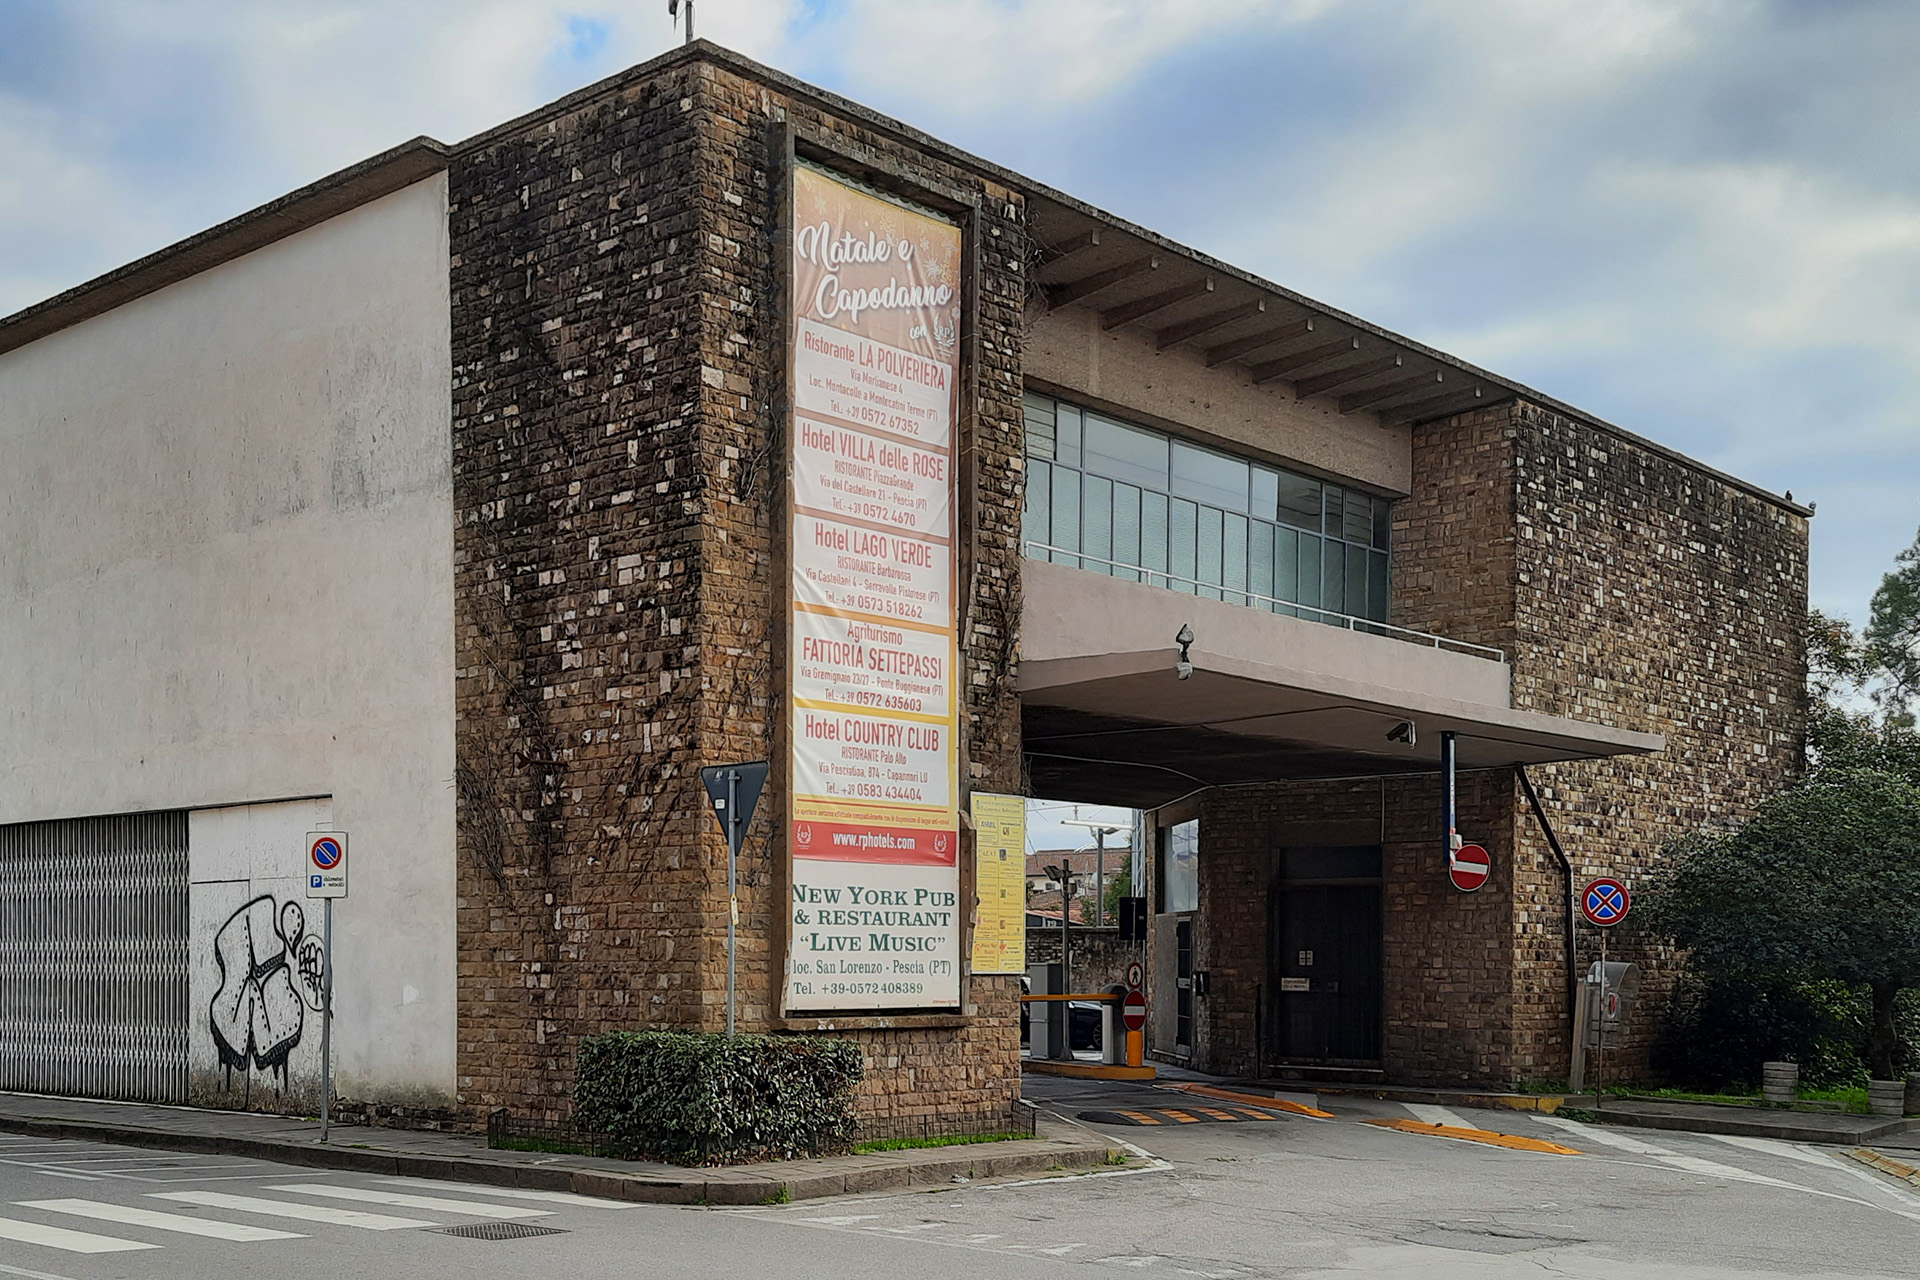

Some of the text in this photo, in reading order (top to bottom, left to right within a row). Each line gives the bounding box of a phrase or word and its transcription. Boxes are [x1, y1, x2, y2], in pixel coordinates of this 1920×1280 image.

[798, 221, 914, 271] Natale e
[816, 274, 952, 324] Capodanno
[804, 331, 945, 391] Ristorante LA POLVERIERA
[850, 368, 860, 381] Via
[899, 384, 903, 395] 4
[809, 374, 824, 389] Loc.
[864, 391, 868, 401] a
[870, 391, 905, 412] Montecatini
[907, 401, 925, 418] Terme
[927, 409, 938, 422] (PT)
[845, 405, 859, 418] +39
[862, 407, 886, 426] 0572
[889, 415, 919, 435] 67352
[802, 423, 944, 480] Hotel VILLA delle ROSE
[835, 460, 914, 491] RISTORANTE PiazzaGrande
[820, 475, 830, 488] Via
[833, 479, 842, 490] del
[844, 481, 876, 498] Castellare
[879, 489, 885, 500] 21
[894, 492, 914, 507] Pescia
[916, 499, 927, 511] (PT)
[847, 503, 861, 514] +39
[864, 504, 888, 521] 0572
[892, 510, 915, 526] 4670
[816, 522, 931, 568] Hotel LAGO VERDE
[838, 556, 911, 582] RISTORANTE Barbarossa
[806, 567, 816, 580] Via
[818, 570, 850, 586] Castellani
[853, 577, 856, 587] 4
[865, 580, 896, 595] Serravalle
[899, 585, 926, 601] Pistoiese
[928, 591, 940, 604] (PT)
[841, 595, 854, 606] +39
[858, 595, 883, 612] 0573
[886, 602, 922, 618] 518262
[848, 621, 902, 645] Agriturismo
[804, 637, 942, 680] FATTORIA SETTEPASSI
[800, 666, 811, 677] Via
[813, 668, 850, 684] Gremignaio
[853, 673, 869, 685] 23/27
[877, 676, 893, 689] Ponte
[896, 678, 930, 696] Buggianese
[932, 684, 943, 696] (PT)
[840, 691, 854, 703] +39
[857, 691, 882, 706] 0572
[885, 695, 921, 711] 635603
[806, 714, 939, 751] Hotel COUNTRY CLUB
[842, 746, 906, 765] RISTORANTE Palo Alto
[819, 762, 829, 773] Via
[868, 766, 880, 779] 874
[887, 769, 918, 783] Capannori
[920, 772, 928, 783] LU
[841, 784, 855, 795] +39
[858, 783, 882, 798] 0583
[885, 786, 921, 800] 434404
[833, 831, 915, 851] www.rphotels.com
[848, 887, 908, 906] YORK
[914, 889, 955, 907] PUB
[794, 909, 950, 926] & RESTAURANT
[817, 960, 836, 974] San
[840, 960, 882, 974] Lorenzo
[893, 960, 924, 974] Pescia
[929, 960, 951, 976] (PT)
[794, 982, 816, 994] Tel.
